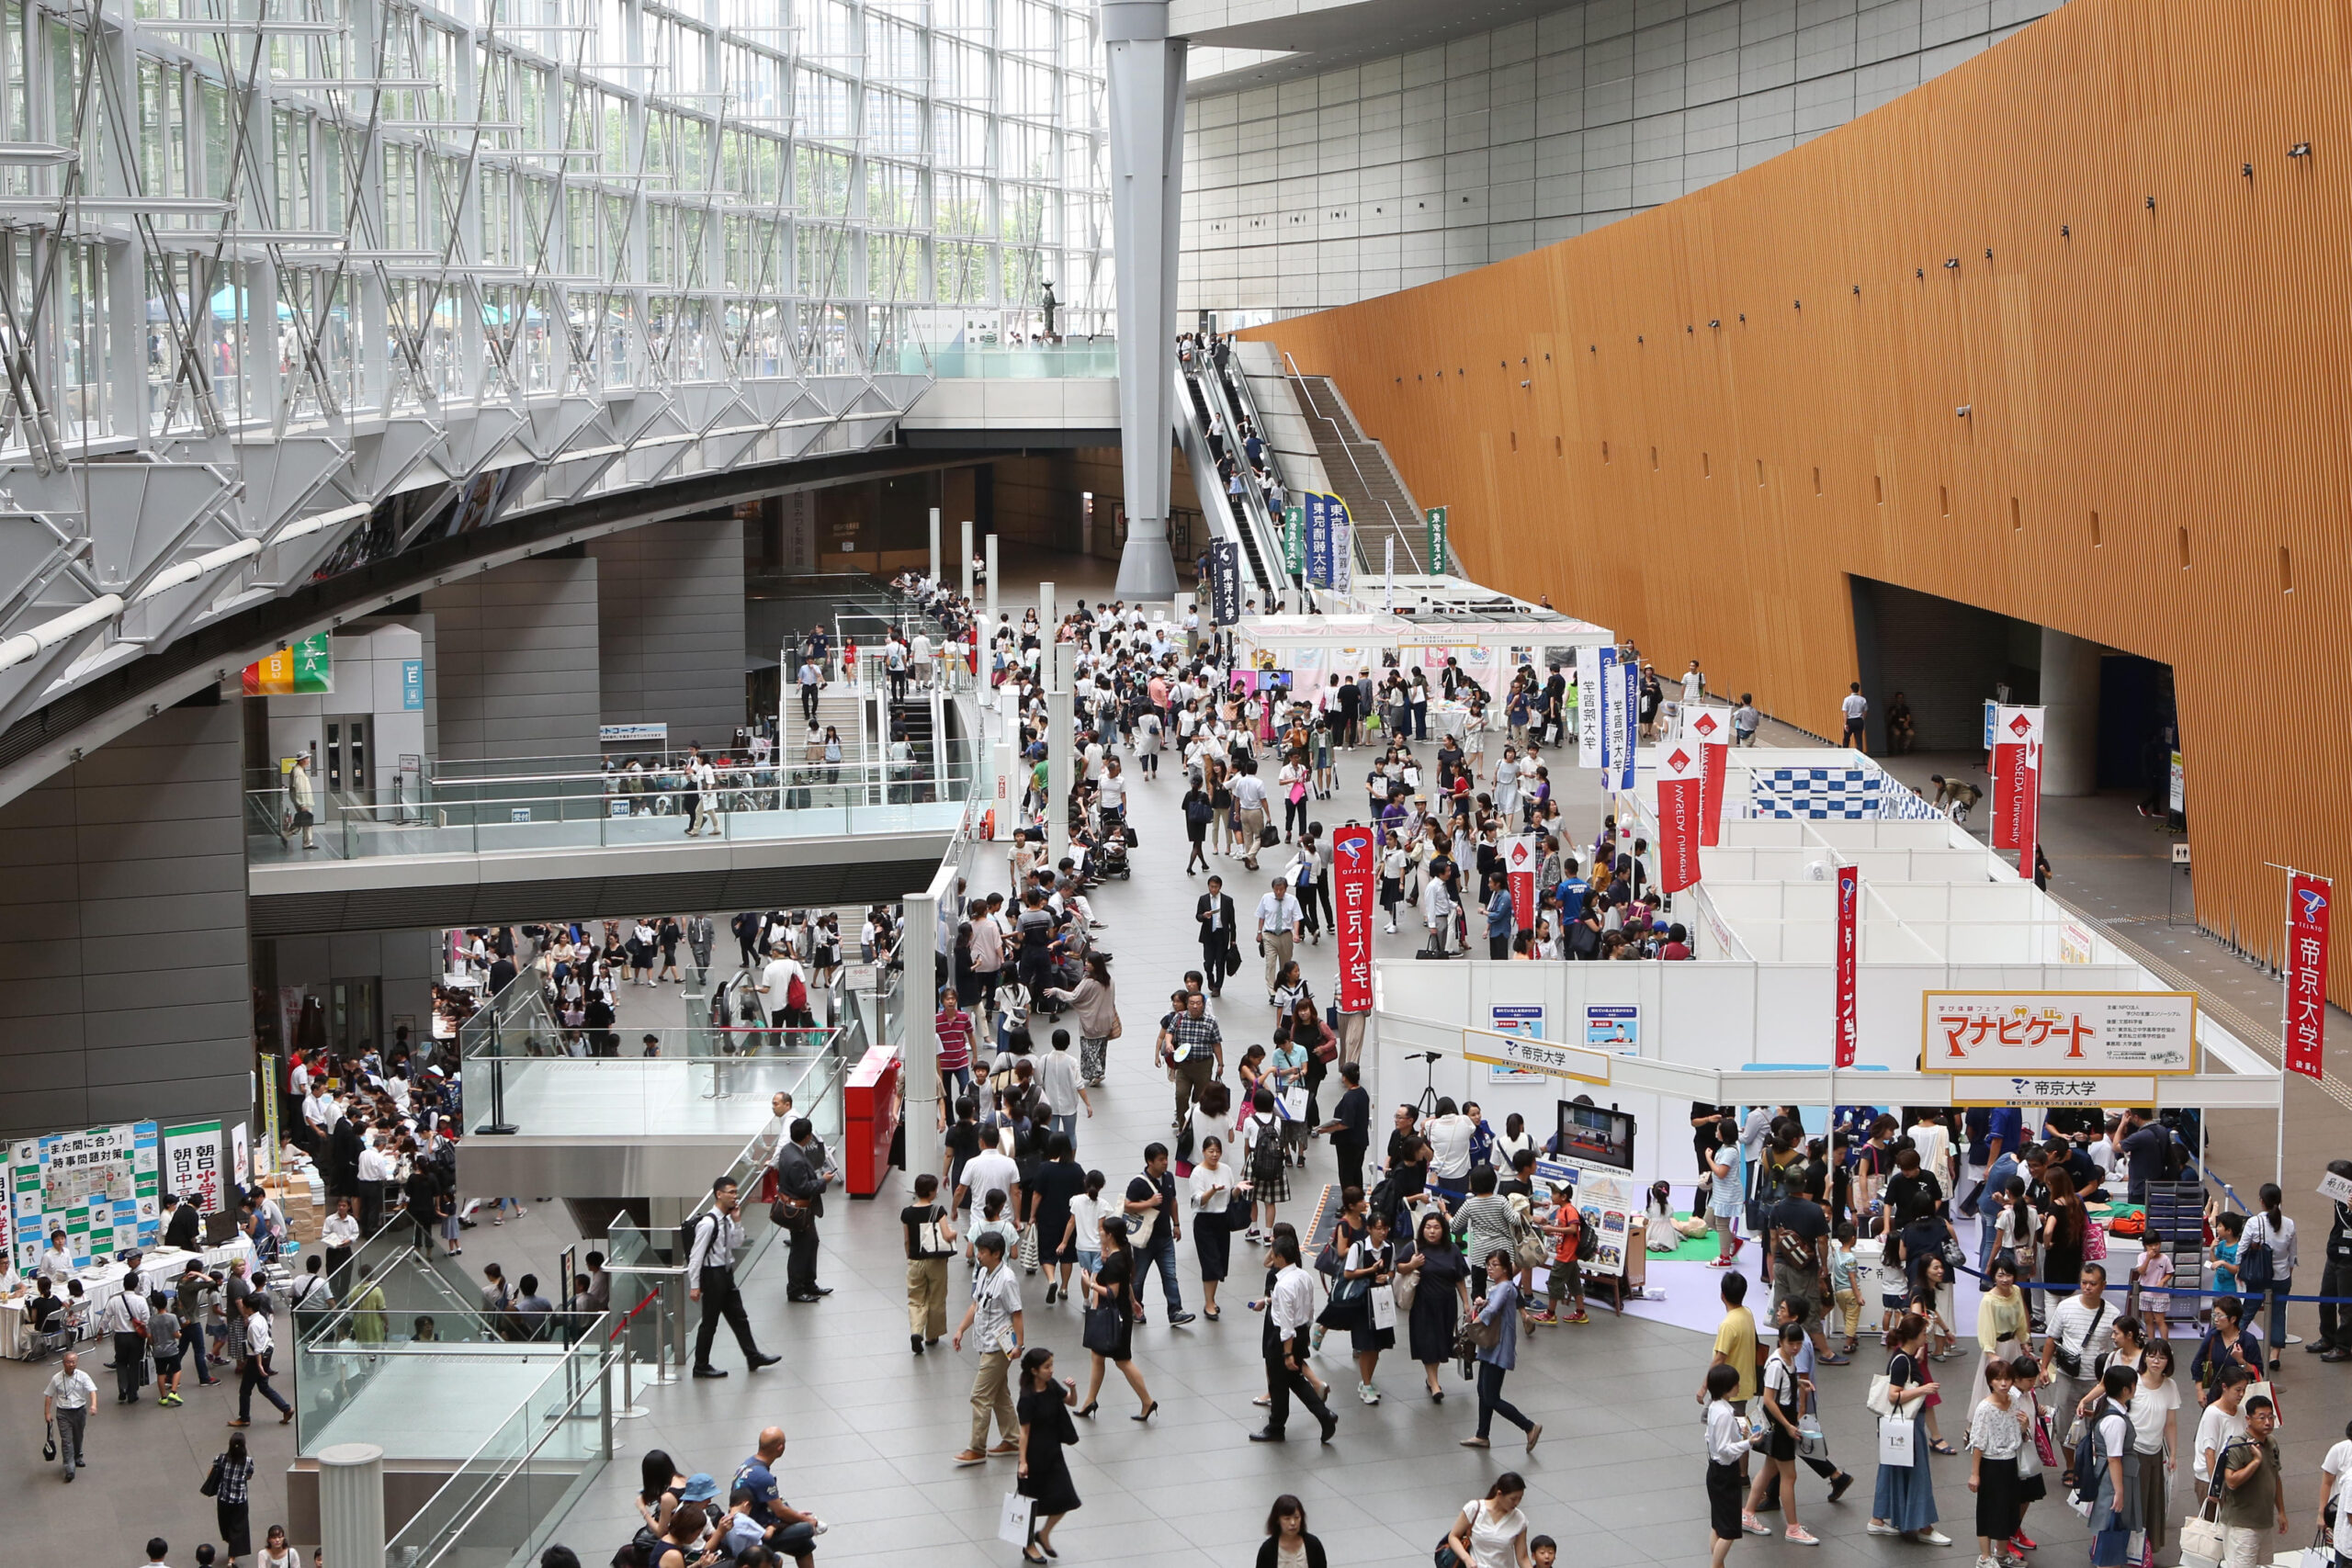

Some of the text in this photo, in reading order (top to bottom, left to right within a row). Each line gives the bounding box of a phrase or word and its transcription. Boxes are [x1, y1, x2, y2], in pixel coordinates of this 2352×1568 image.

[1223, 569, 1235, 620] 東洋大学
[271, 660, 282, 671] B
[305, 659, 316, 671] A
[408, 671, 418, 683] E
[2009, 748, 2025, 843] WASEDA University
[613, 803, 628, 815] 受付
[2299, 922, 2323, 932] TEIKYO
[2298, 936, 2321, 1052] 帝京大学
[1938, 1006, 2096, 1059] マナビゲート
[1521, 1045, 1566, 1066] 帝京大学
[2295, 1059, 2317, 1074] 後援会
[2034, 1080, 2097, 1096] 帝京大学
[52, 1148, 123, 1168] 時事問題対策
